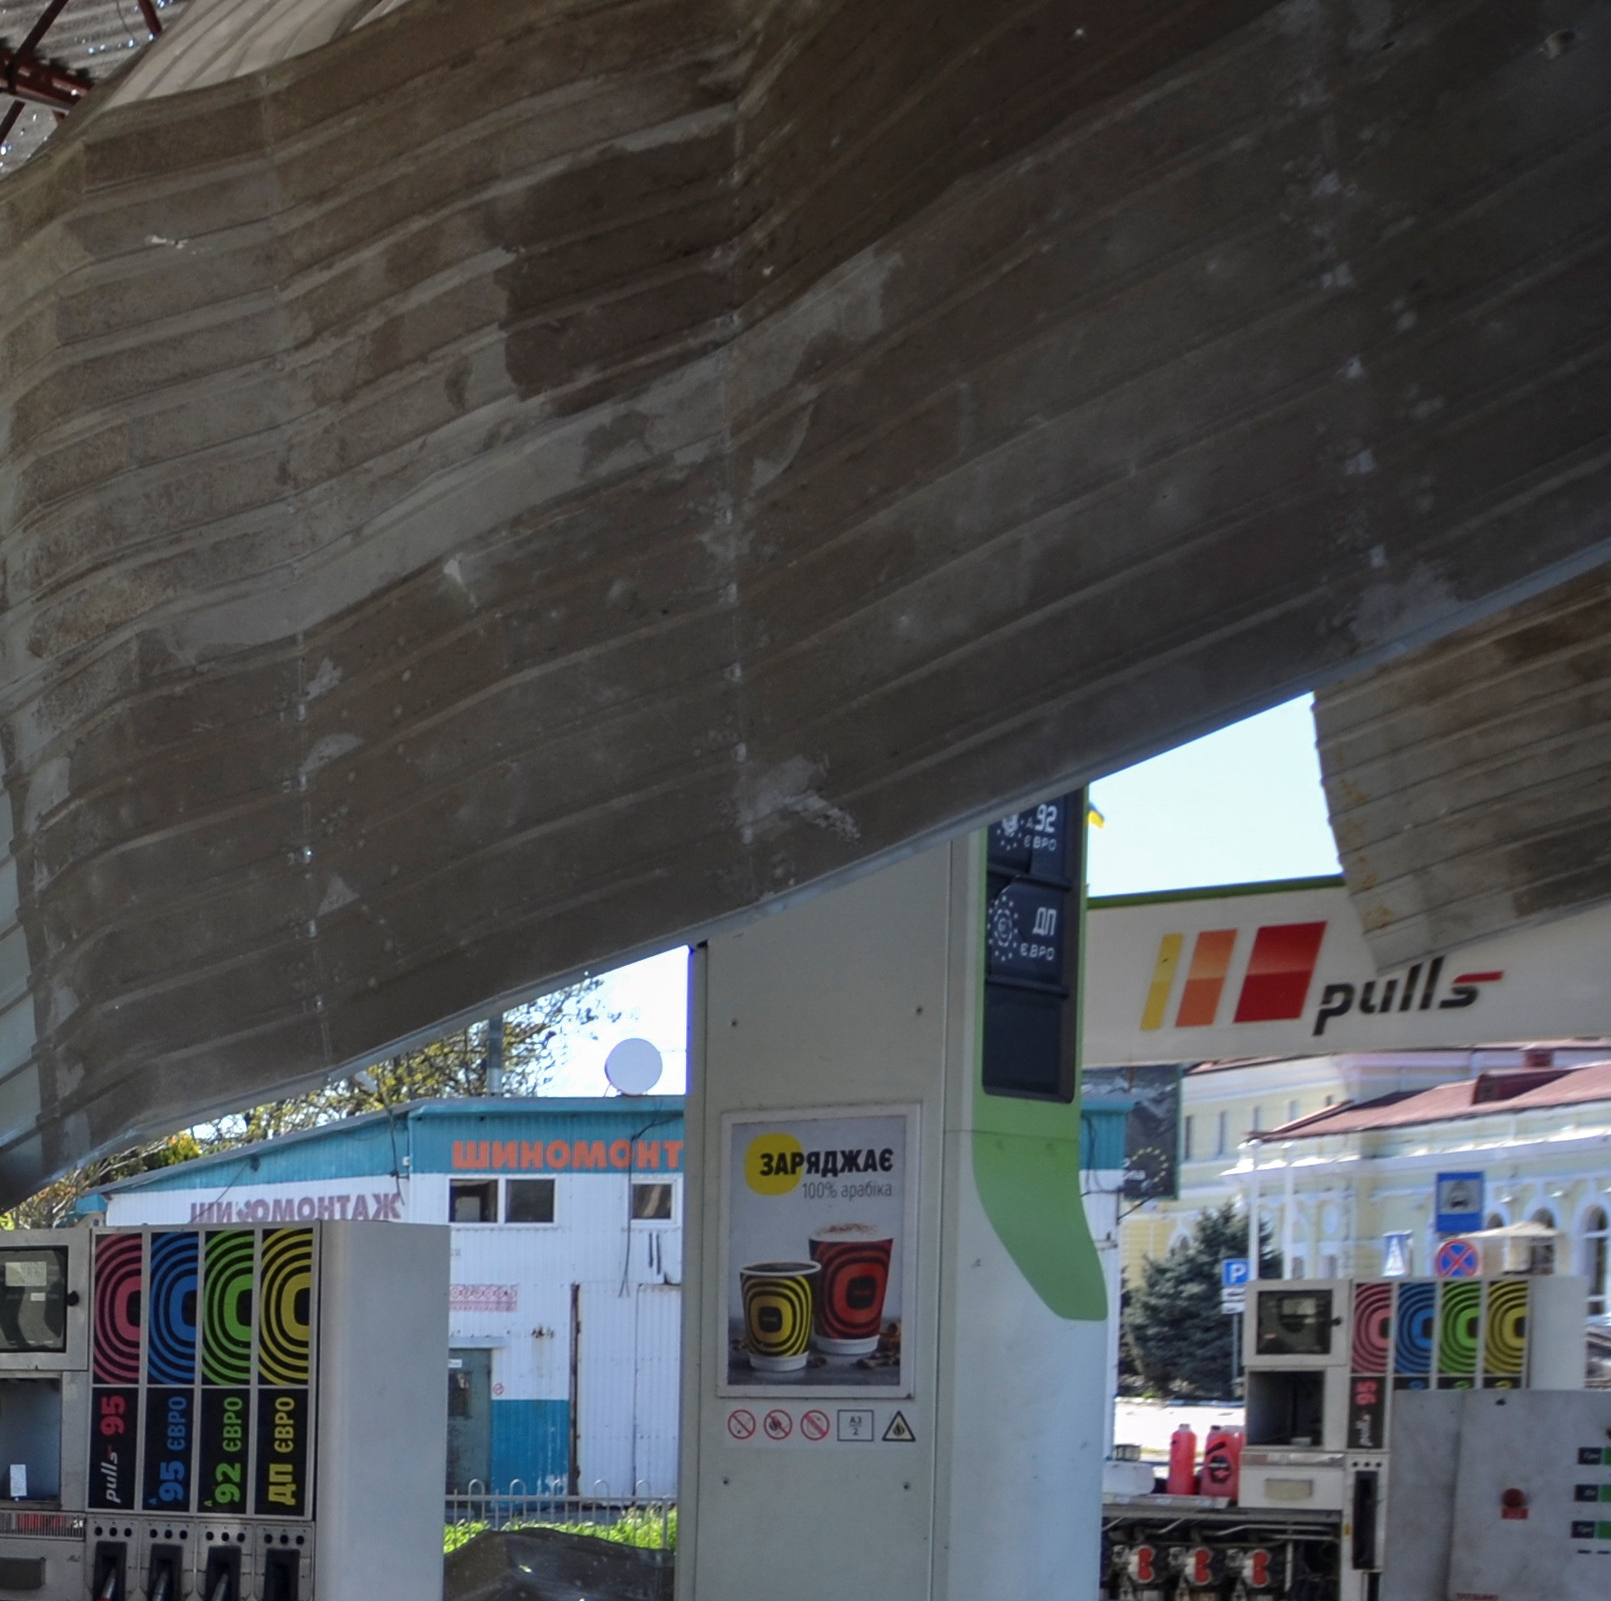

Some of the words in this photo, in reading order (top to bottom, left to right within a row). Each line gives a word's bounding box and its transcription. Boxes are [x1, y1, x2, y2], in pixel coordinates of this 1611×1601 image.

[1023, 836, 1057, 851] ЄВРО
[1032, 906, 1057, 936] ДП
[1019, 943, 1055, 960] ЄВРО
[1312, 955, 1505, 1036] pulls
[759, 1148, 894, 1178] ЗАРЯДЖАЄ
[801, 1182, 838, 1199] 100%
[840, 1181, 893, 1201] арабіка
[1229, 1263, 1246, 1284] P
[99, 1394, 127, 1437] 95
[166, 1396, 187, 1450] ЄВРО
[222, 1397, 243, 1452] ЄВРО
[273, 1397, 295, 1453] ЄВРО
[100, 1445, 122, 1504] pulls
[268, 1463, 297, 1506] ДП
